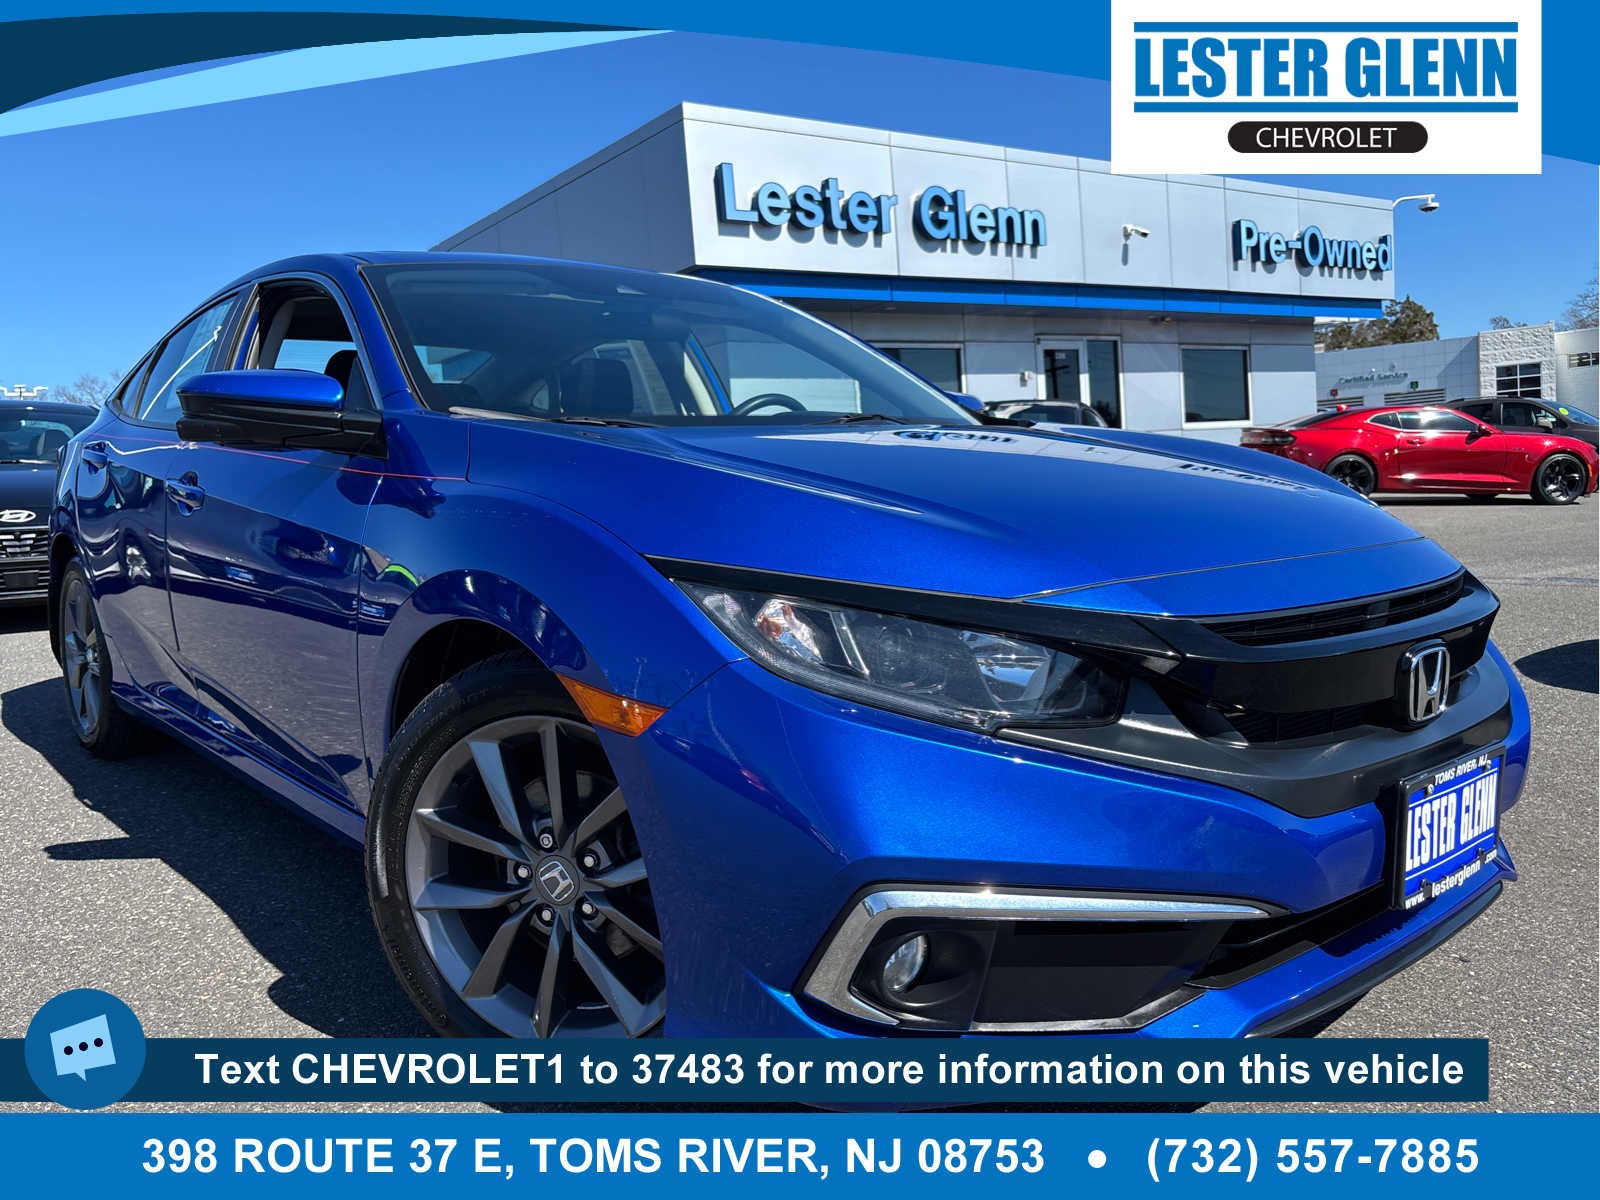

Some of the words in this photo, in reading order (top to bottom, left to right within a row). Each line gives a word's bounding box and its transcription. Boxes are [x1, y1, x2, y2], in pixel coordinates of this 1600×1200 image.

[714, 163, 898, 234] Lester
[913, 185, 1047, 247] Glenn
[1232, 219, 1392, 271] Pre-Owned
[1434, 768, 1455, 786] TOMS
[1405, 792, 1457, 872] LESTER
[1460, 772, 1497, 845] GLENN
[1431, 860, 1481, 898] lesterglenn
